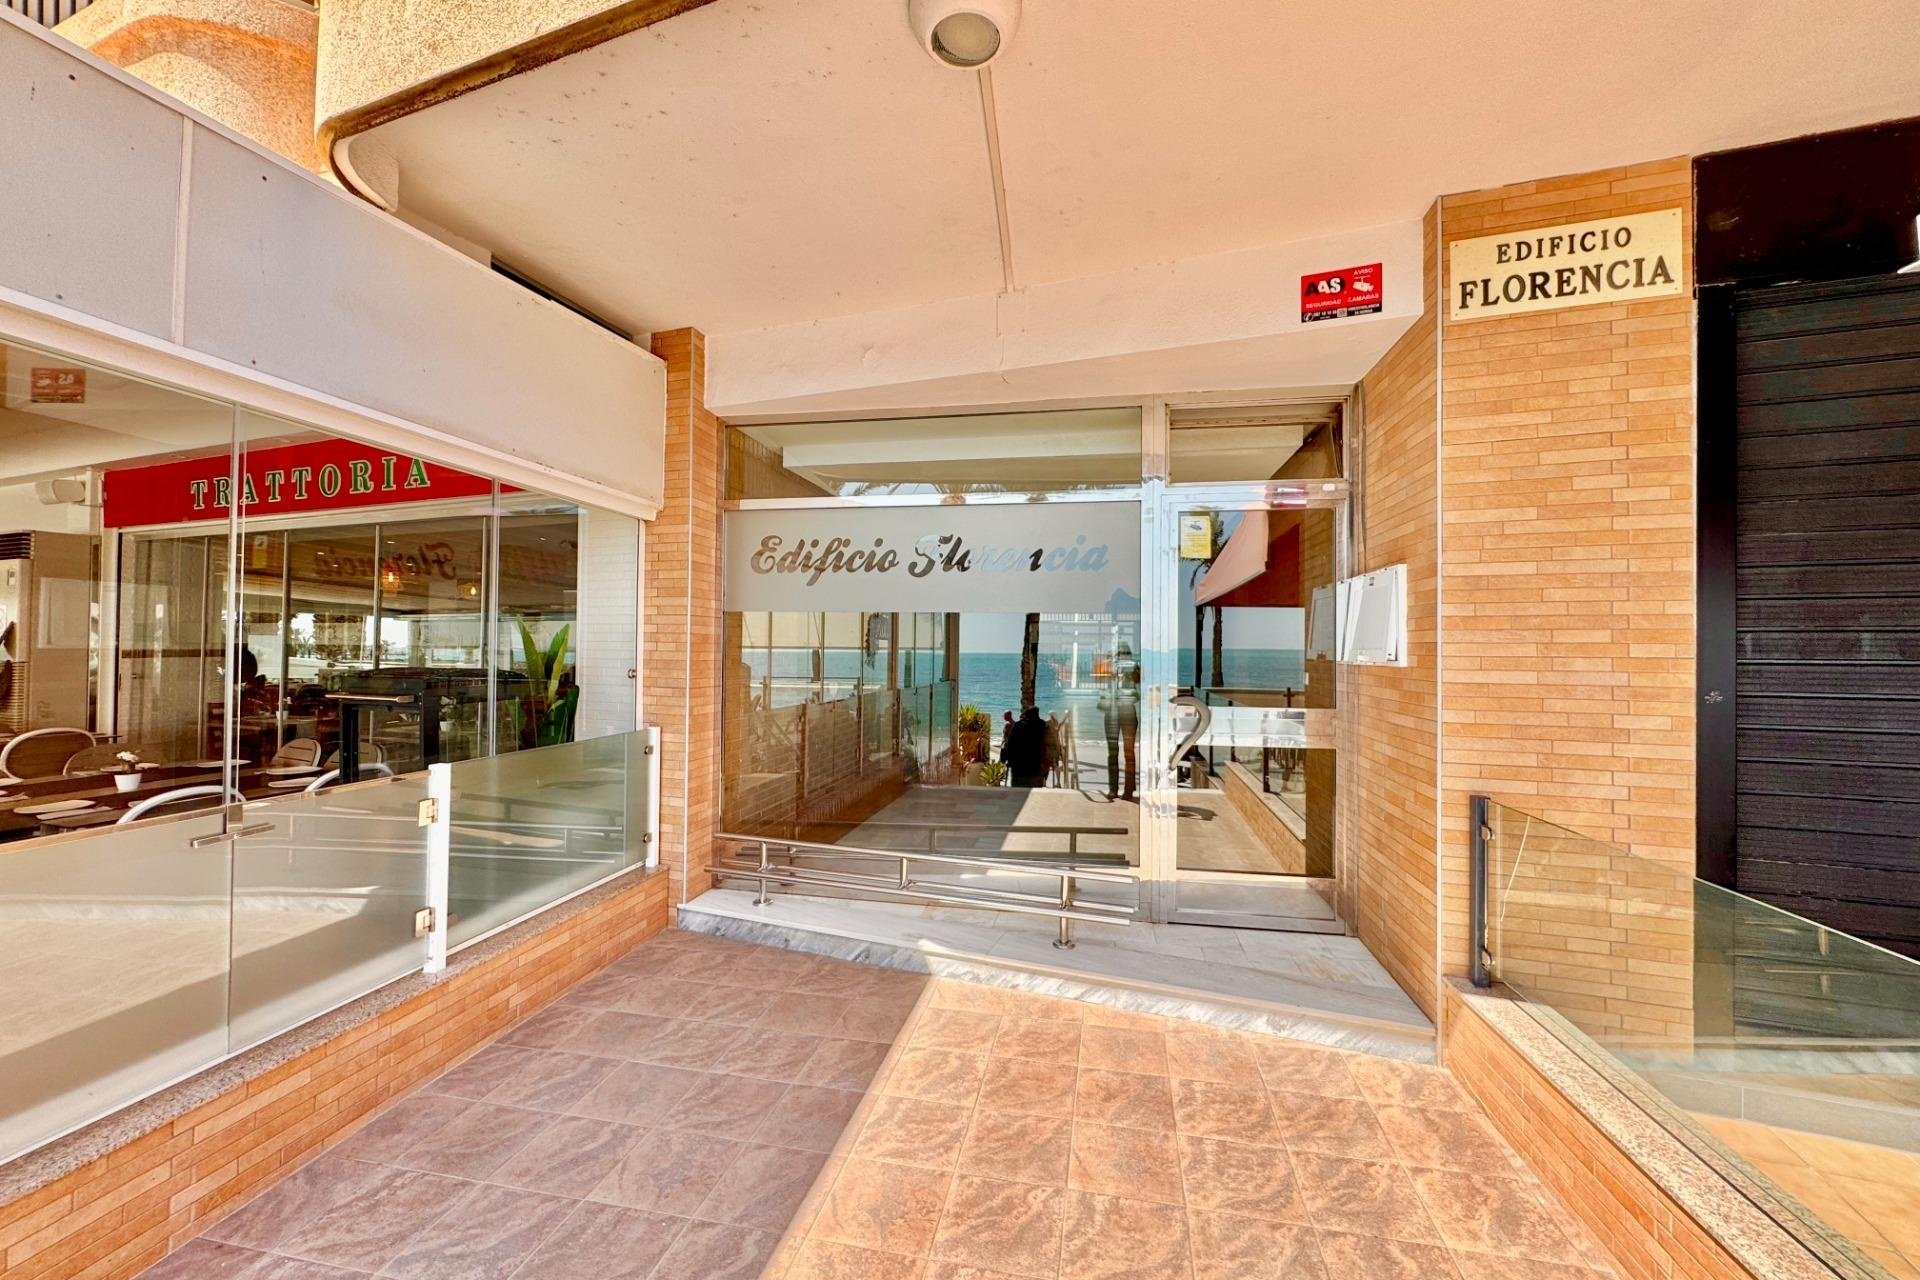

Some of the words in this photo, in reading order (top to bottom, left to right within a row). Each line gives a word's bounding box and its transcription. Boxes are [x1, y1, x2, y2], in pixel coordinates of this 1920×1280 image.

[1496, 226, 1632, 264] EDIFICIO
[1353, 267, 1374, 276] AVISO
[1458, 255, 1675, 310] FLORENCIA
[1305, 299, 1342, 309] SEGURIDAD
[191, 456, 431, 510] TRATTORIA
[750, 534, 899, 587] Edificio
[907, 533, 1110, 578] Florencia
